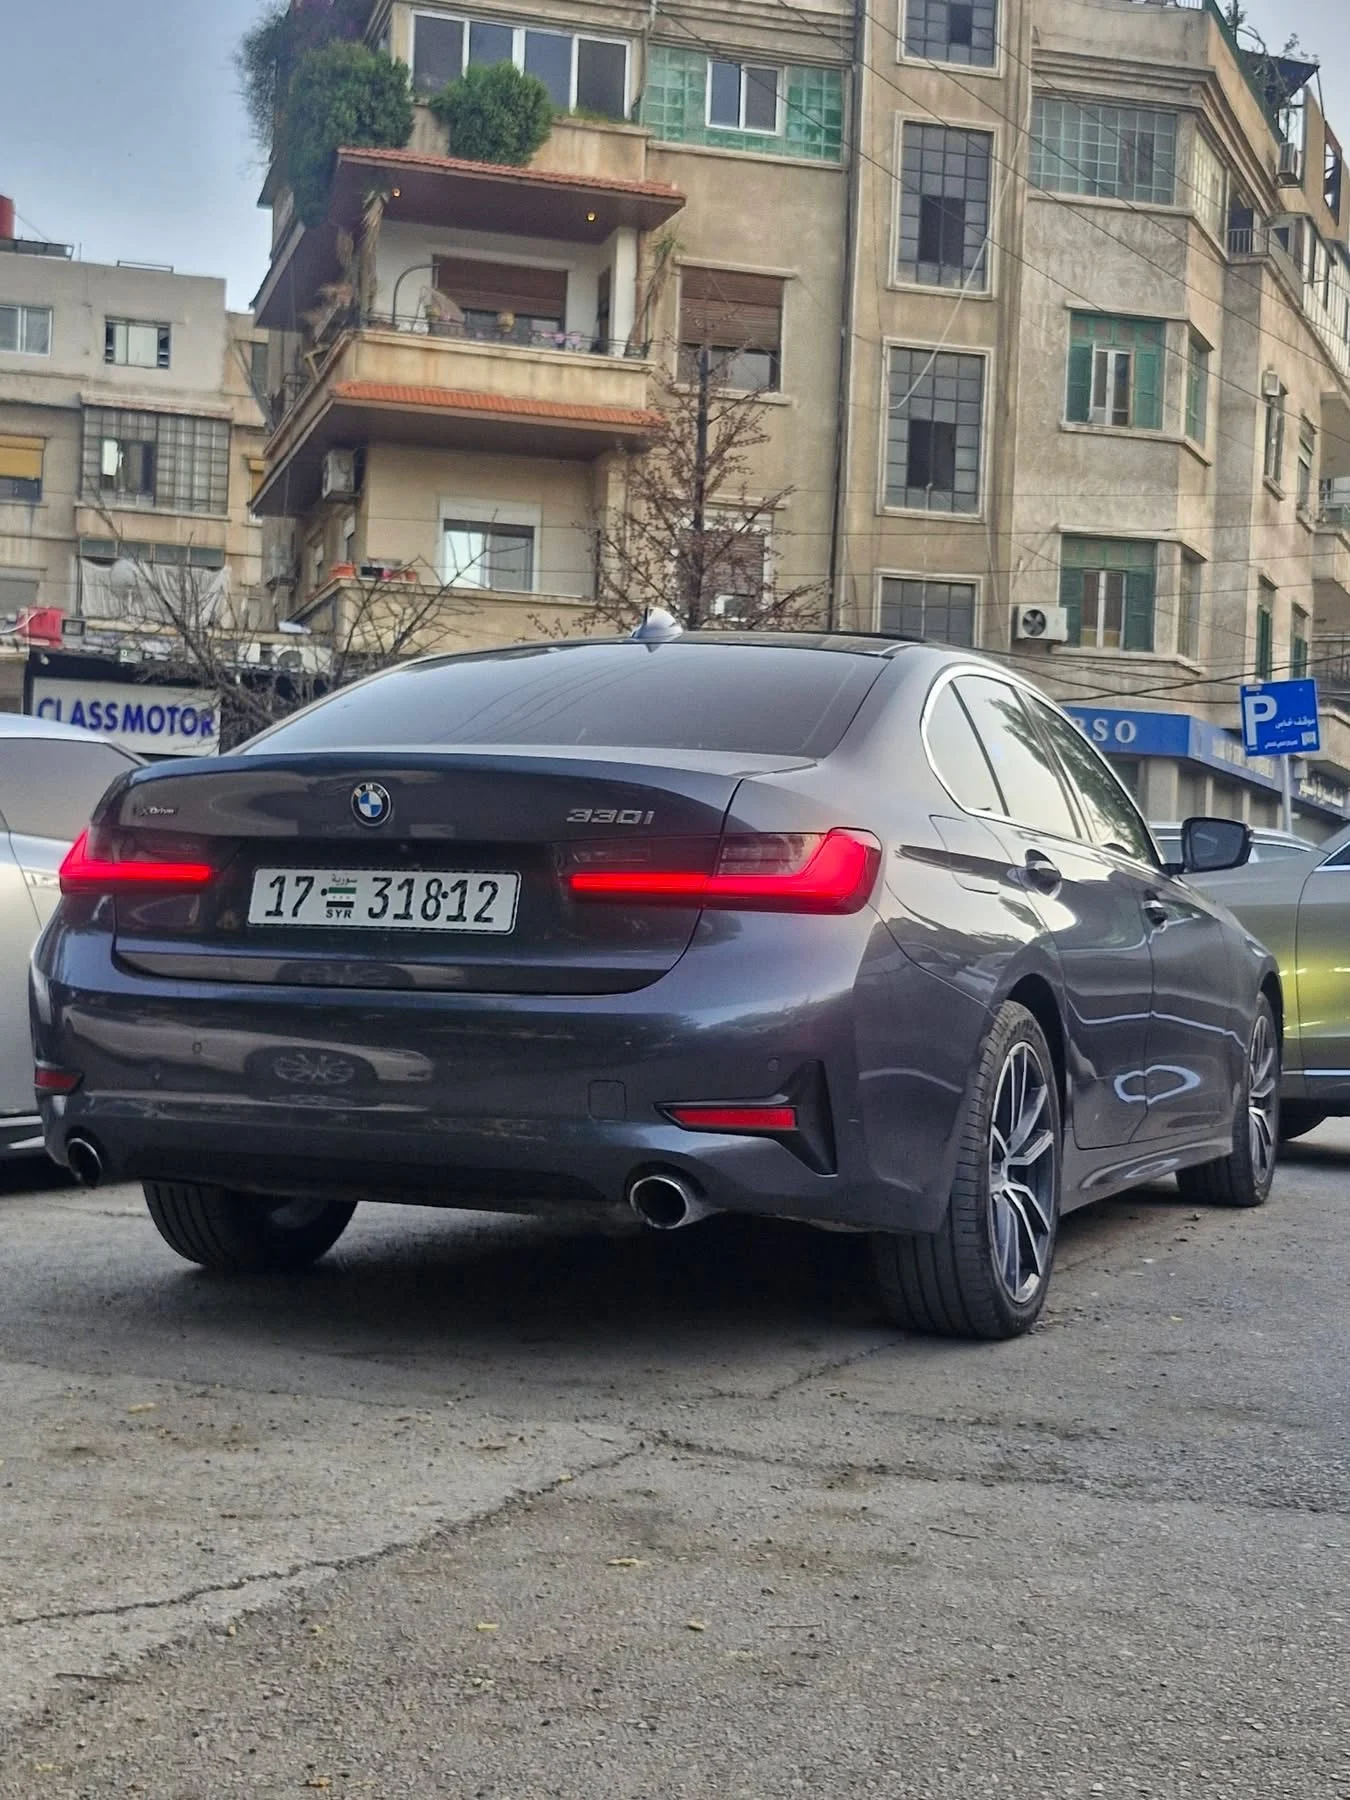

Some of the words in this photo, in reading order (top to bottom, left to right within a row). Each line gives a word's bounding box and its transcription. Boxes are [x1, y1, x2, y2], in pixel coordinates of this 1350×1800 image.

[1244, 695, 1277, 747] P
[566, 808, 655, 825] 330i
[332, 873, 358, 886] سورية
[265, 875, 315, 918] 17
[367, 876, 500, 924] 31812
[326, 908, 352, 919] SYR
